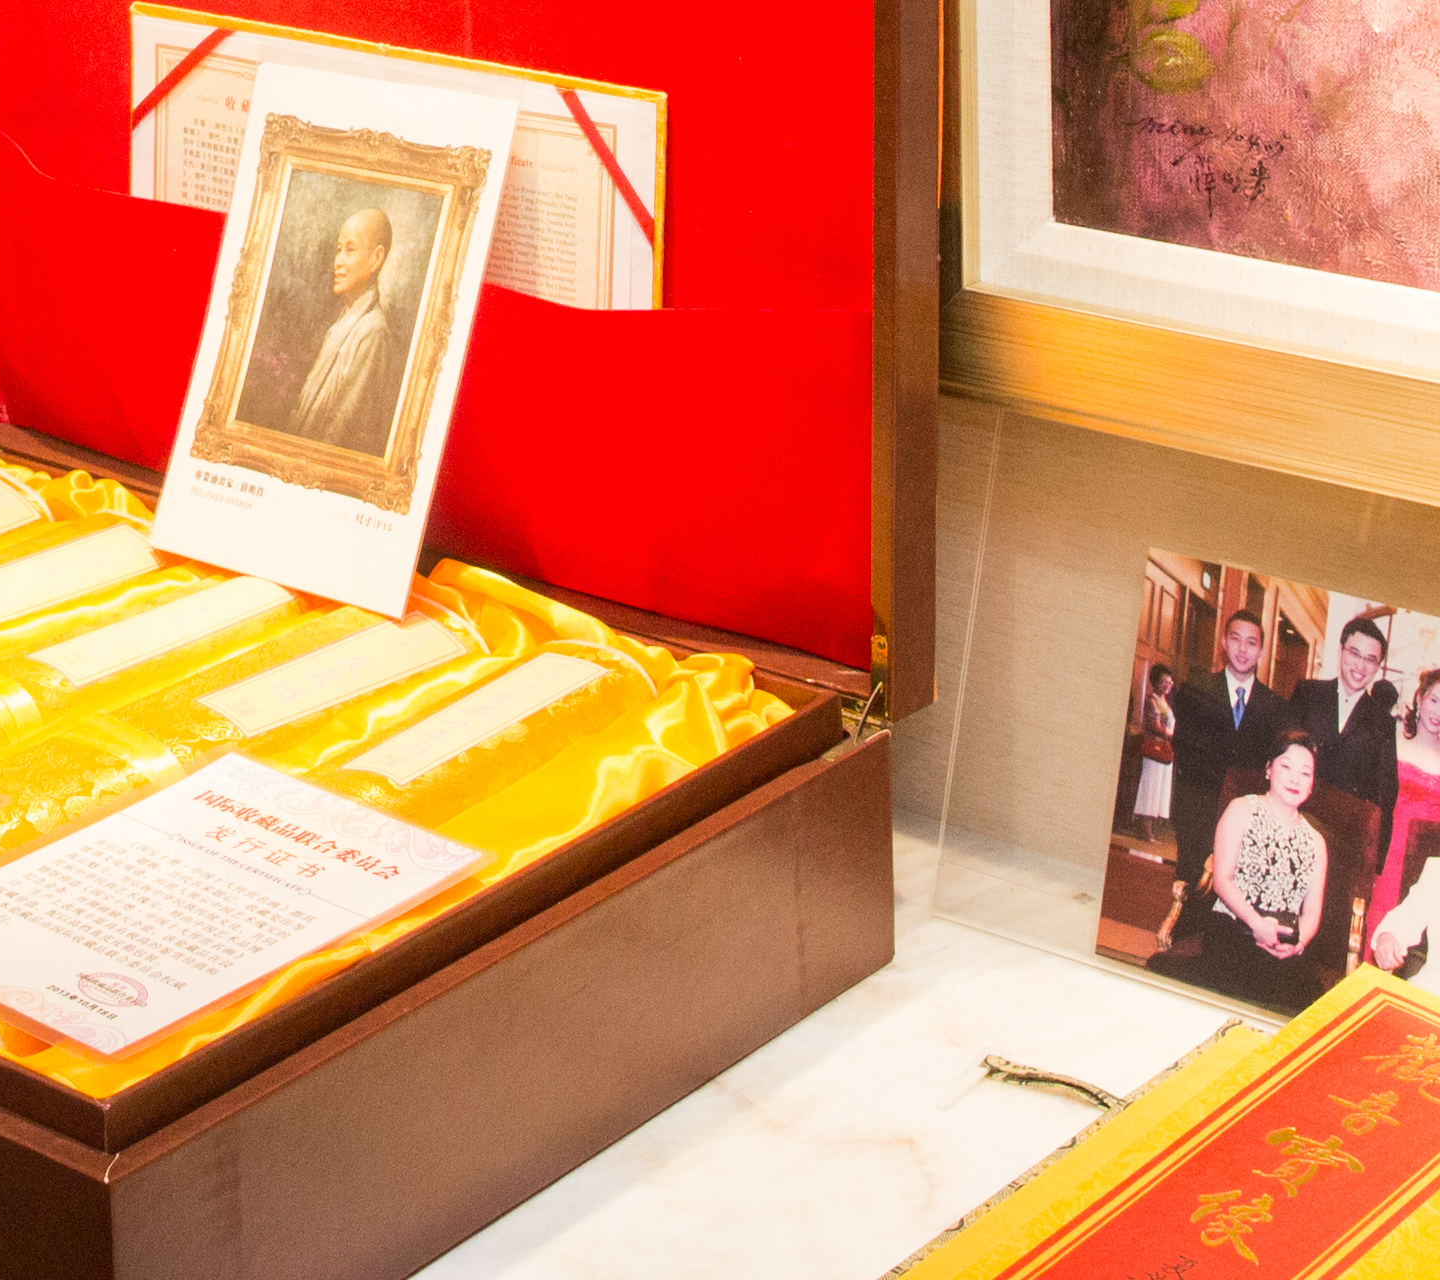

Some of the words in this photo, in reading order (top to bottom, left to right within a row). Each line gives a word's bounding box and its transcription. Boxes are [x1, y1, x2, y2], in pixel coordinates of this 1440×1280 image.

[192, 789, 401, 880] 国际收藏品联合委员会
[204, 824, 326, 879] 发行证书
[42, 983, 120, 1021] 2013年10月18日
